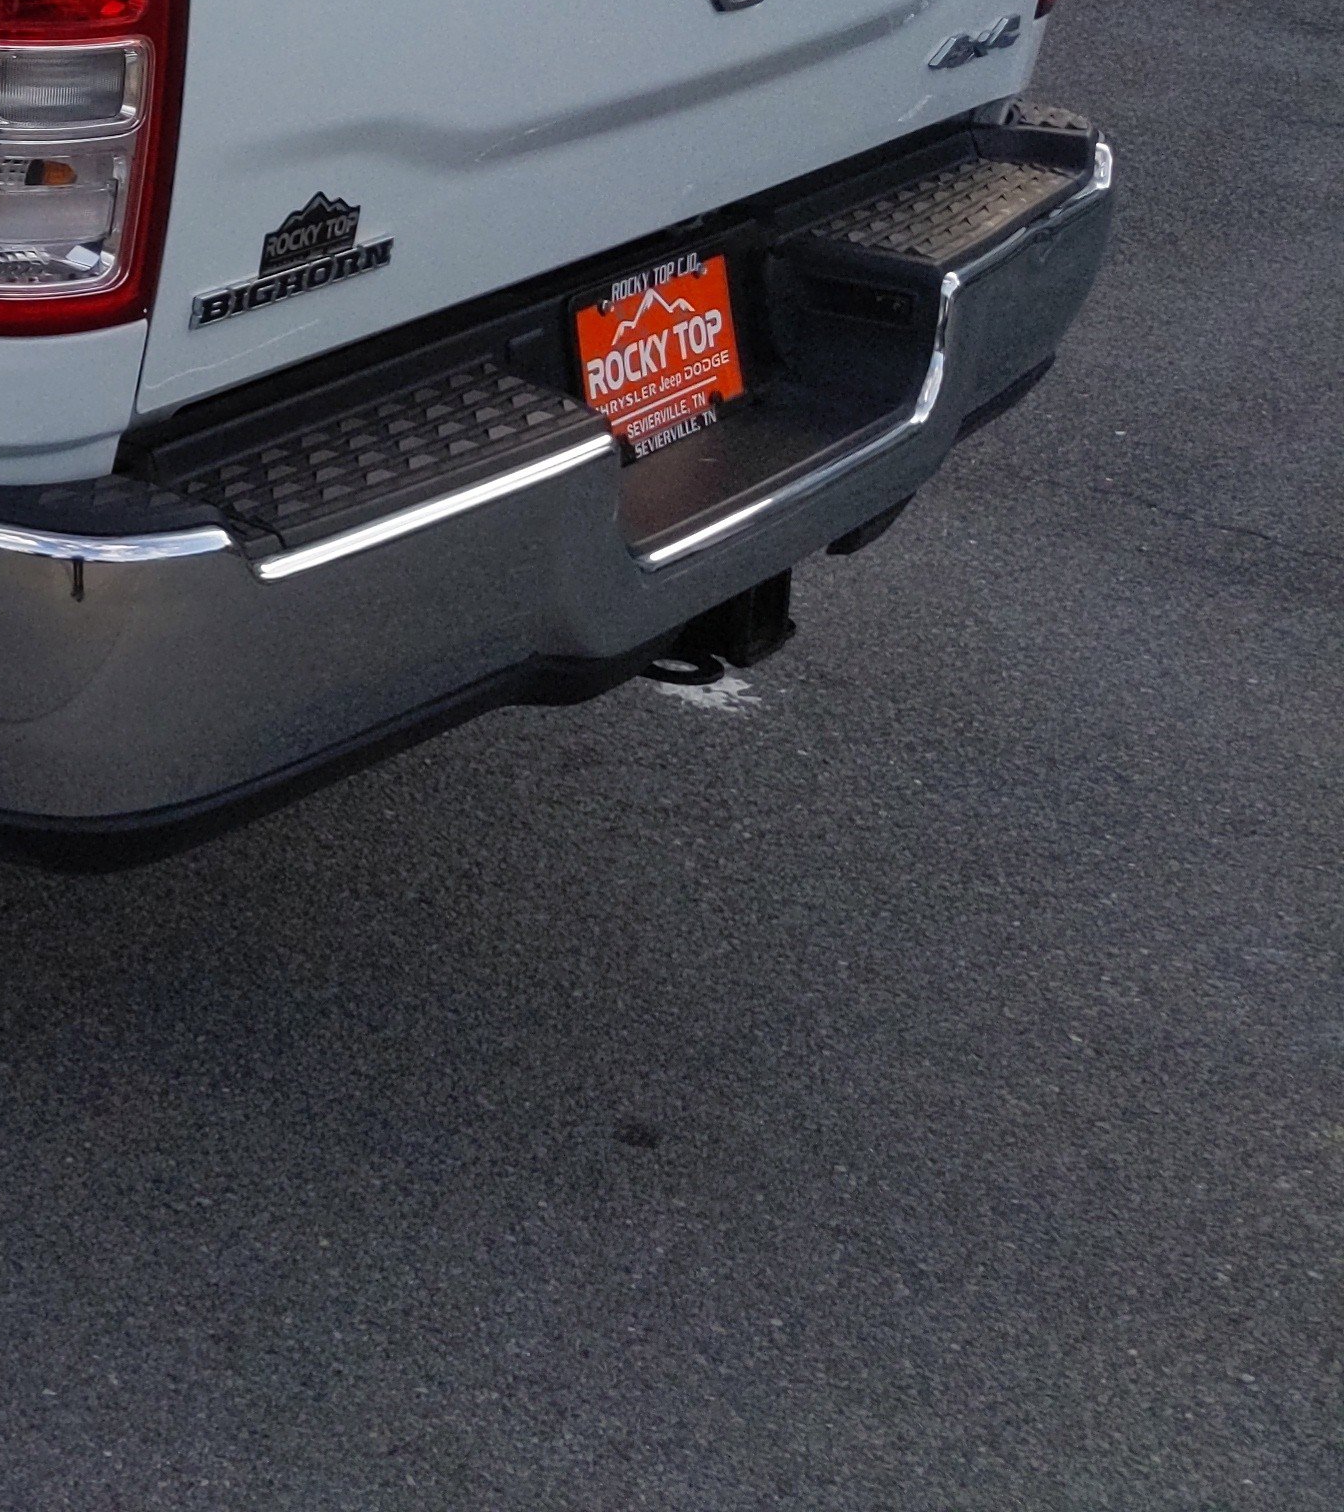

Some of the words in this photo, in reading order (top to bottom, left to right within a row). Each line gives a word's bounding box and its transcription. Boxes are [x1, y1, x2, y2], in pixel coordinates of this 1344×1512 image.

[265, 221, 320, 257] ROCKY
[325, 211, 359, 239] TOP
[611, 272, 650, 304] ROCKY
[653, 261, 675, 286] TOP
[586, 329, 668, 399] ROCKY
[673, 308, 723, 360] TOP
[596, 382, 657, 415] HRYSLER
[658, 373, 682, 392] Jeep
[684, 349, 730, 381] DODGE
[626, 399, 691, 439] SEVIERVILLE,
[692, 392, 706, 406] TN
[634, 417, 701, 459] SEVIERVILLE,
[702, 409, 717, 426] TN
